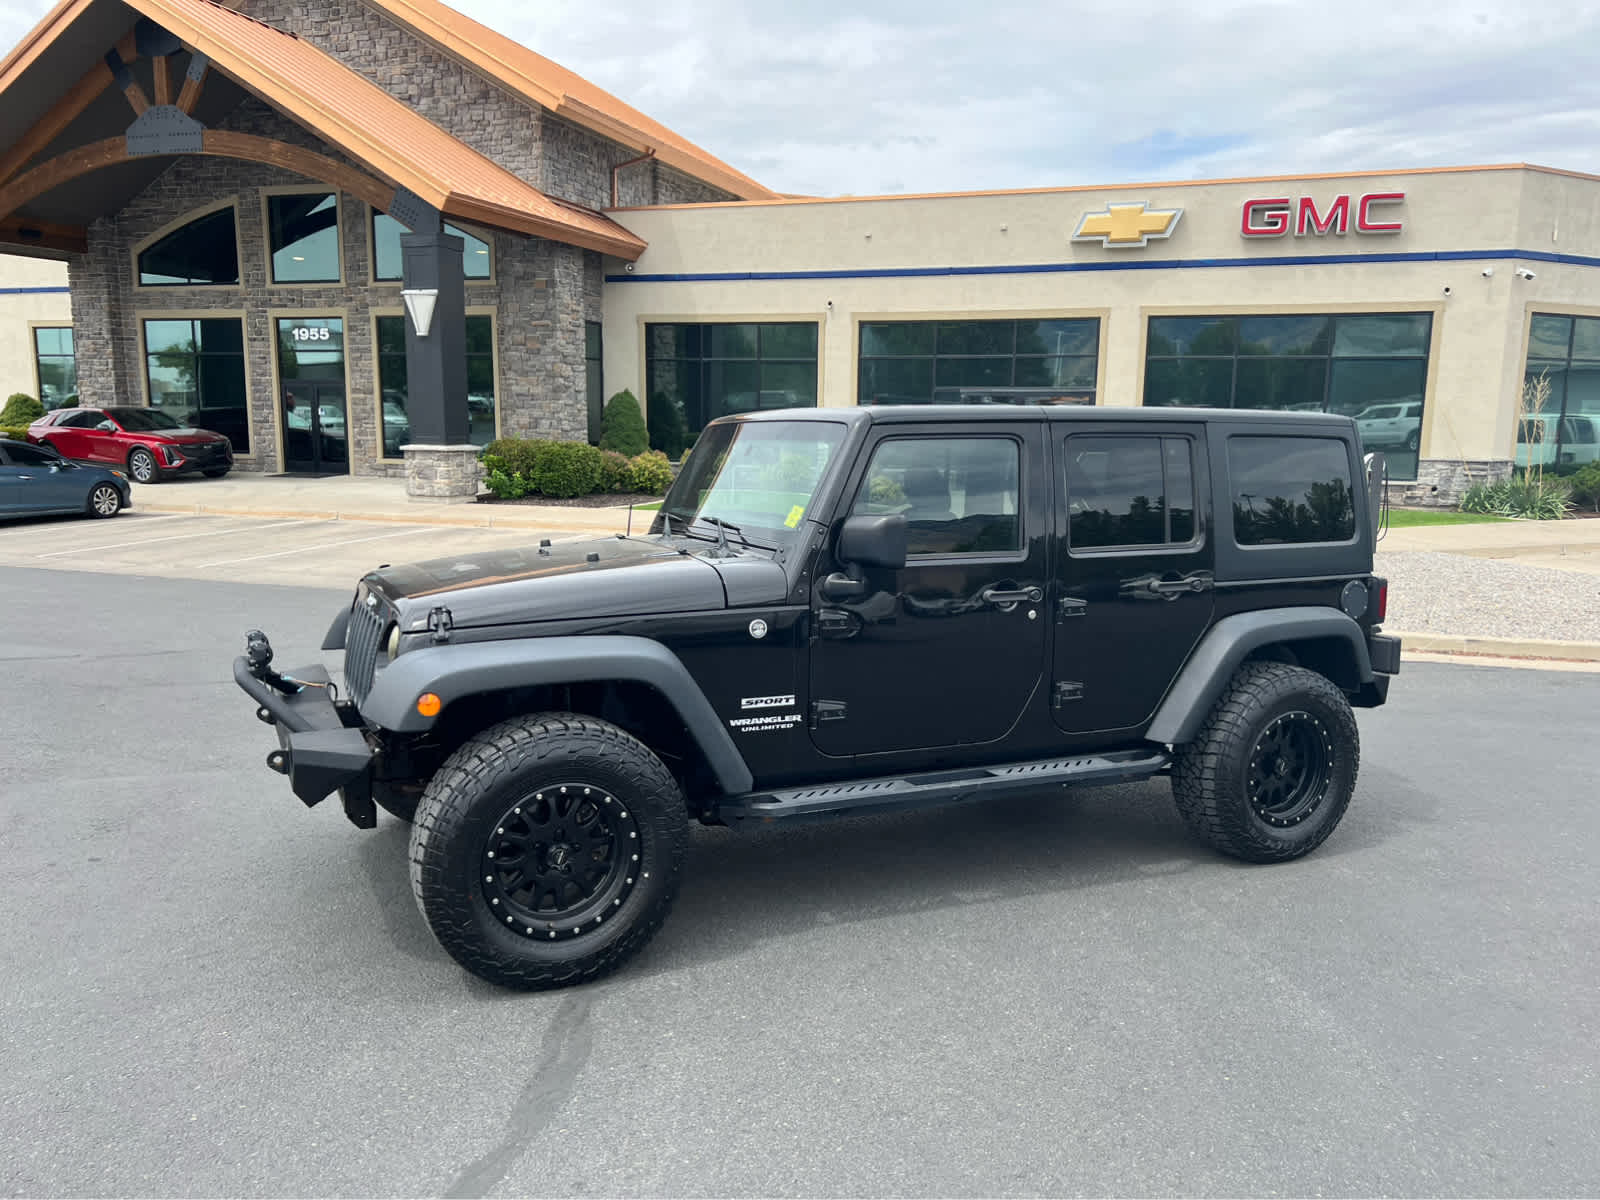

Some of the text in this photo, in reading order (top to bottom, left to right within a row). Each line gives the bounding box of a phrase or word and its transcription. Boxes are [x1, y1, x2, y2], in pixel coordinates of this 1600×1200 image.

[1241, 192, 1406, 238] GMC
[292, 327, 330, 341] 1955
[743, 697, 793, 707] SPORT
[730, 715, 802, 726] WRANGLER
[741, 723, 794, 732] UNLIMITED
